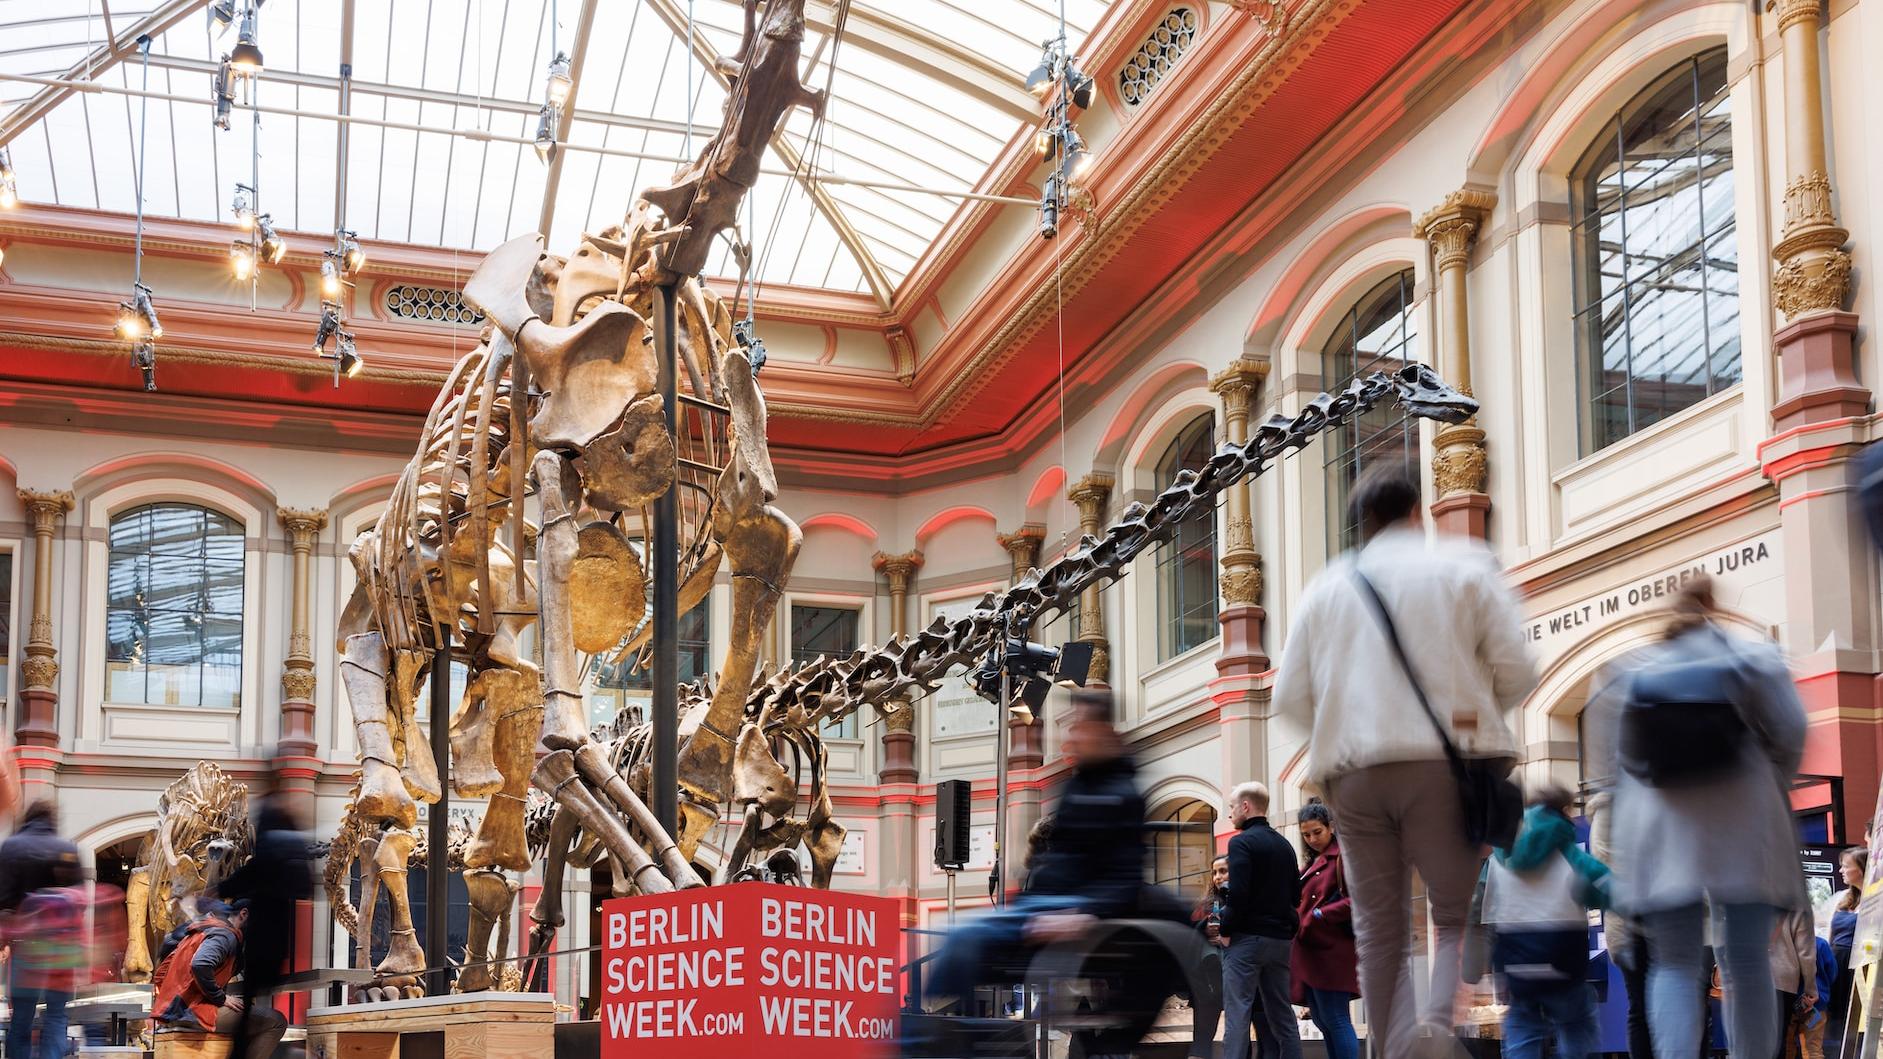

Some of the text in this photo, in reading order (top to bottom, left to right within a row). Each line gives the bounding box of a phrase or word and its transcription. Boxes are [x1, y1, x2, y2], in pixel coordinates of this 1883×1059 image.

[1549, 605, 1592, 635] WELT
[1600, 595, 1620, 617] IM
[1716, 542, 1769, 576] JURA
[609, 900, 724, 949] BERLIN
[761, 897, 876, 947] BERLIN
[607, 946, 745, 994] SCIENCE
[759, 947, 894, 994] SCIENCE
[606, 998, 744, 1039] WEEK.COM
[759, 996, 894, 1040] WEEK.COM
